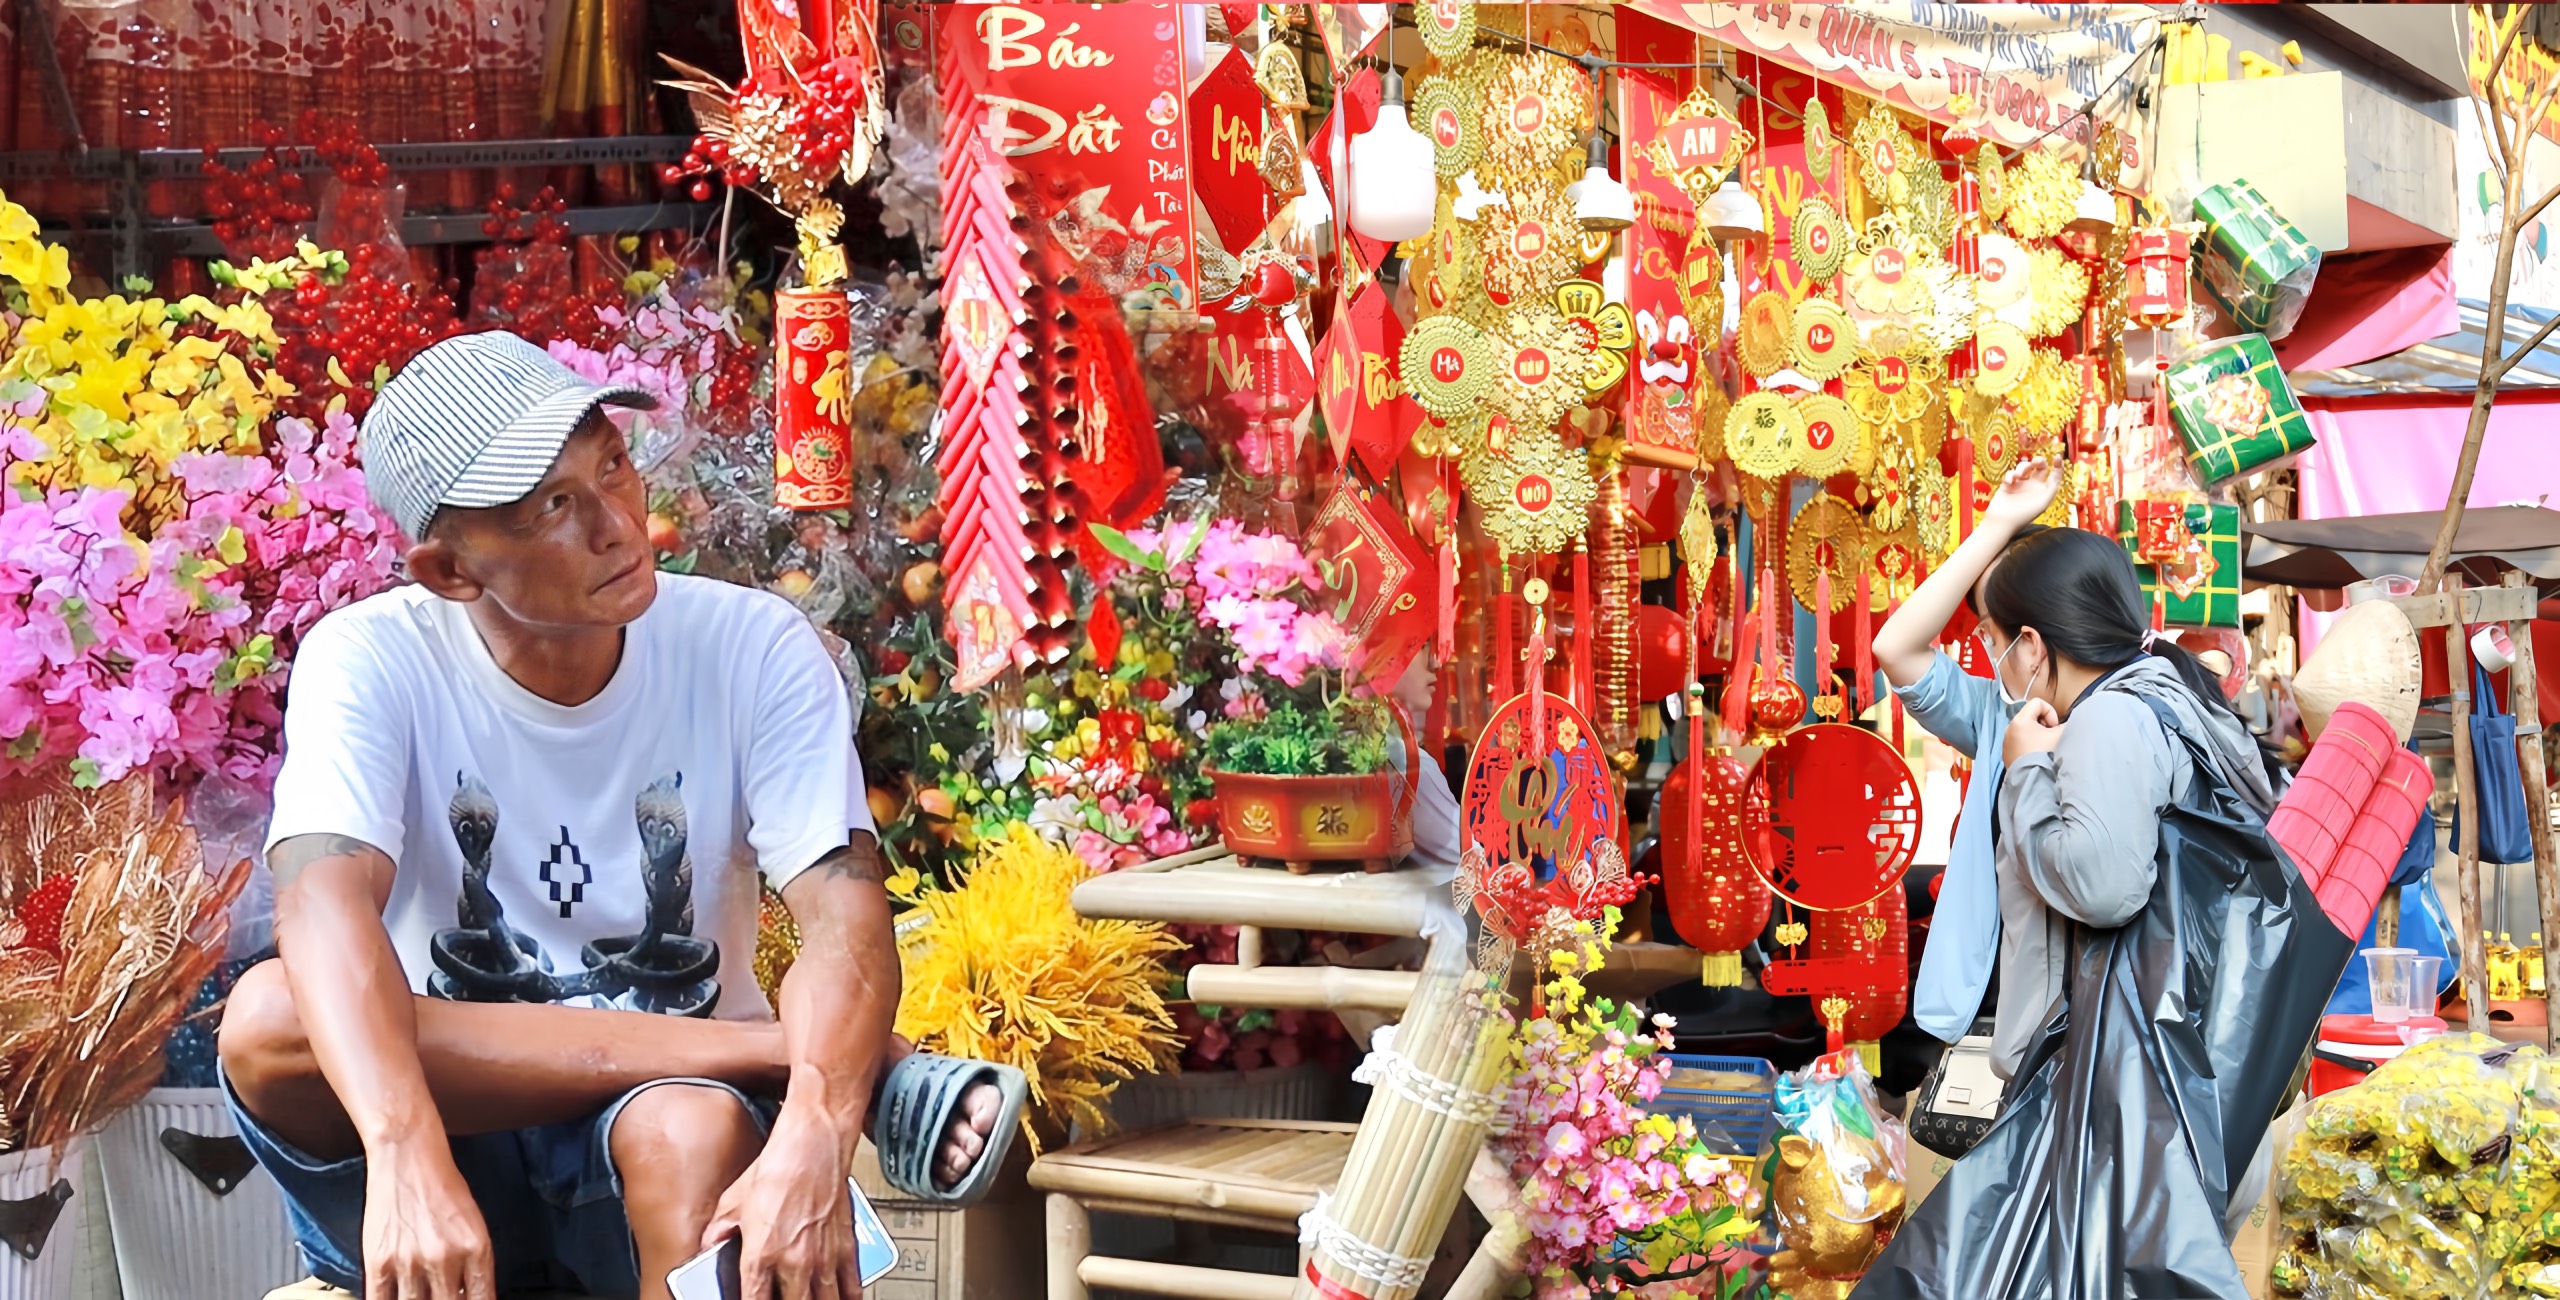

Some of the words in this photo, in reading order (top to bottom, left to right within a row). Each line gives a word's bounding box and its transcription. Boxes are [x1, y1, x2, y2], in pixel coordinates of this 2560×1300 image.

[976, 5, 1114, 72] Bán
[1818, 6, 1895, 72] QUẬN
[1900, 39, 1922, 80] 5
[1682, 127, 1716, 157] AN
[1153, 191, 1183, 215] Tài
[1812, 424, 1828, 446] Ý
